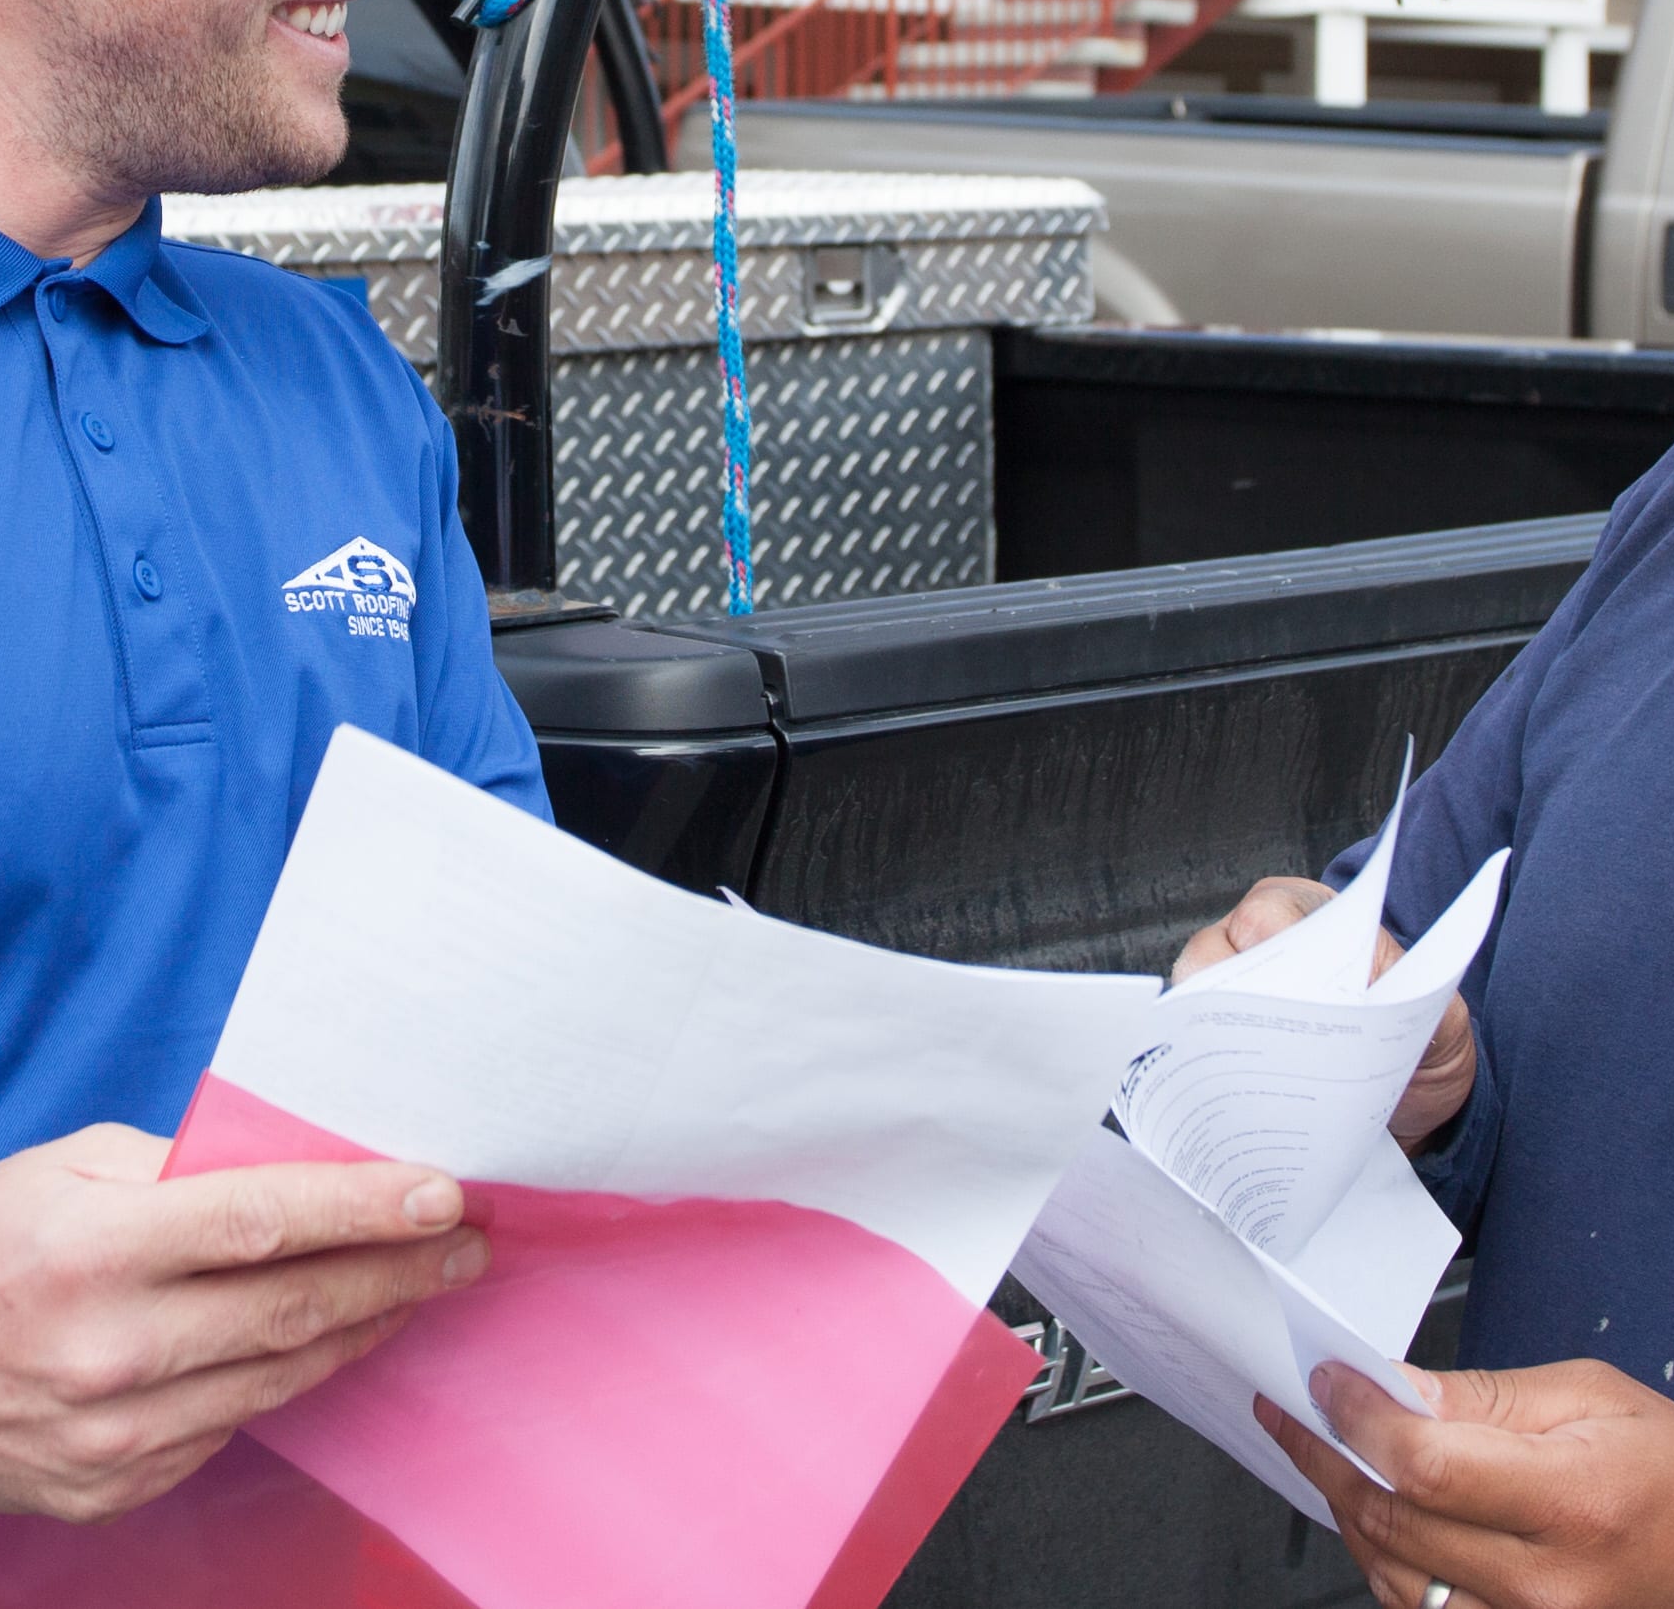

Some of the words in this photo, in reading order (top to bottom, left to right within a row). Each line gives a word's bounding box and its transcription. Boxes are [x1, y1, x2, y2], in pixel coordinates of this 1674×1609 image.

[284, 589, 346, 613] SCOTT
[352, 593, 411, 621] ROOFIN
[348, 615, 385, 637] SINCE
